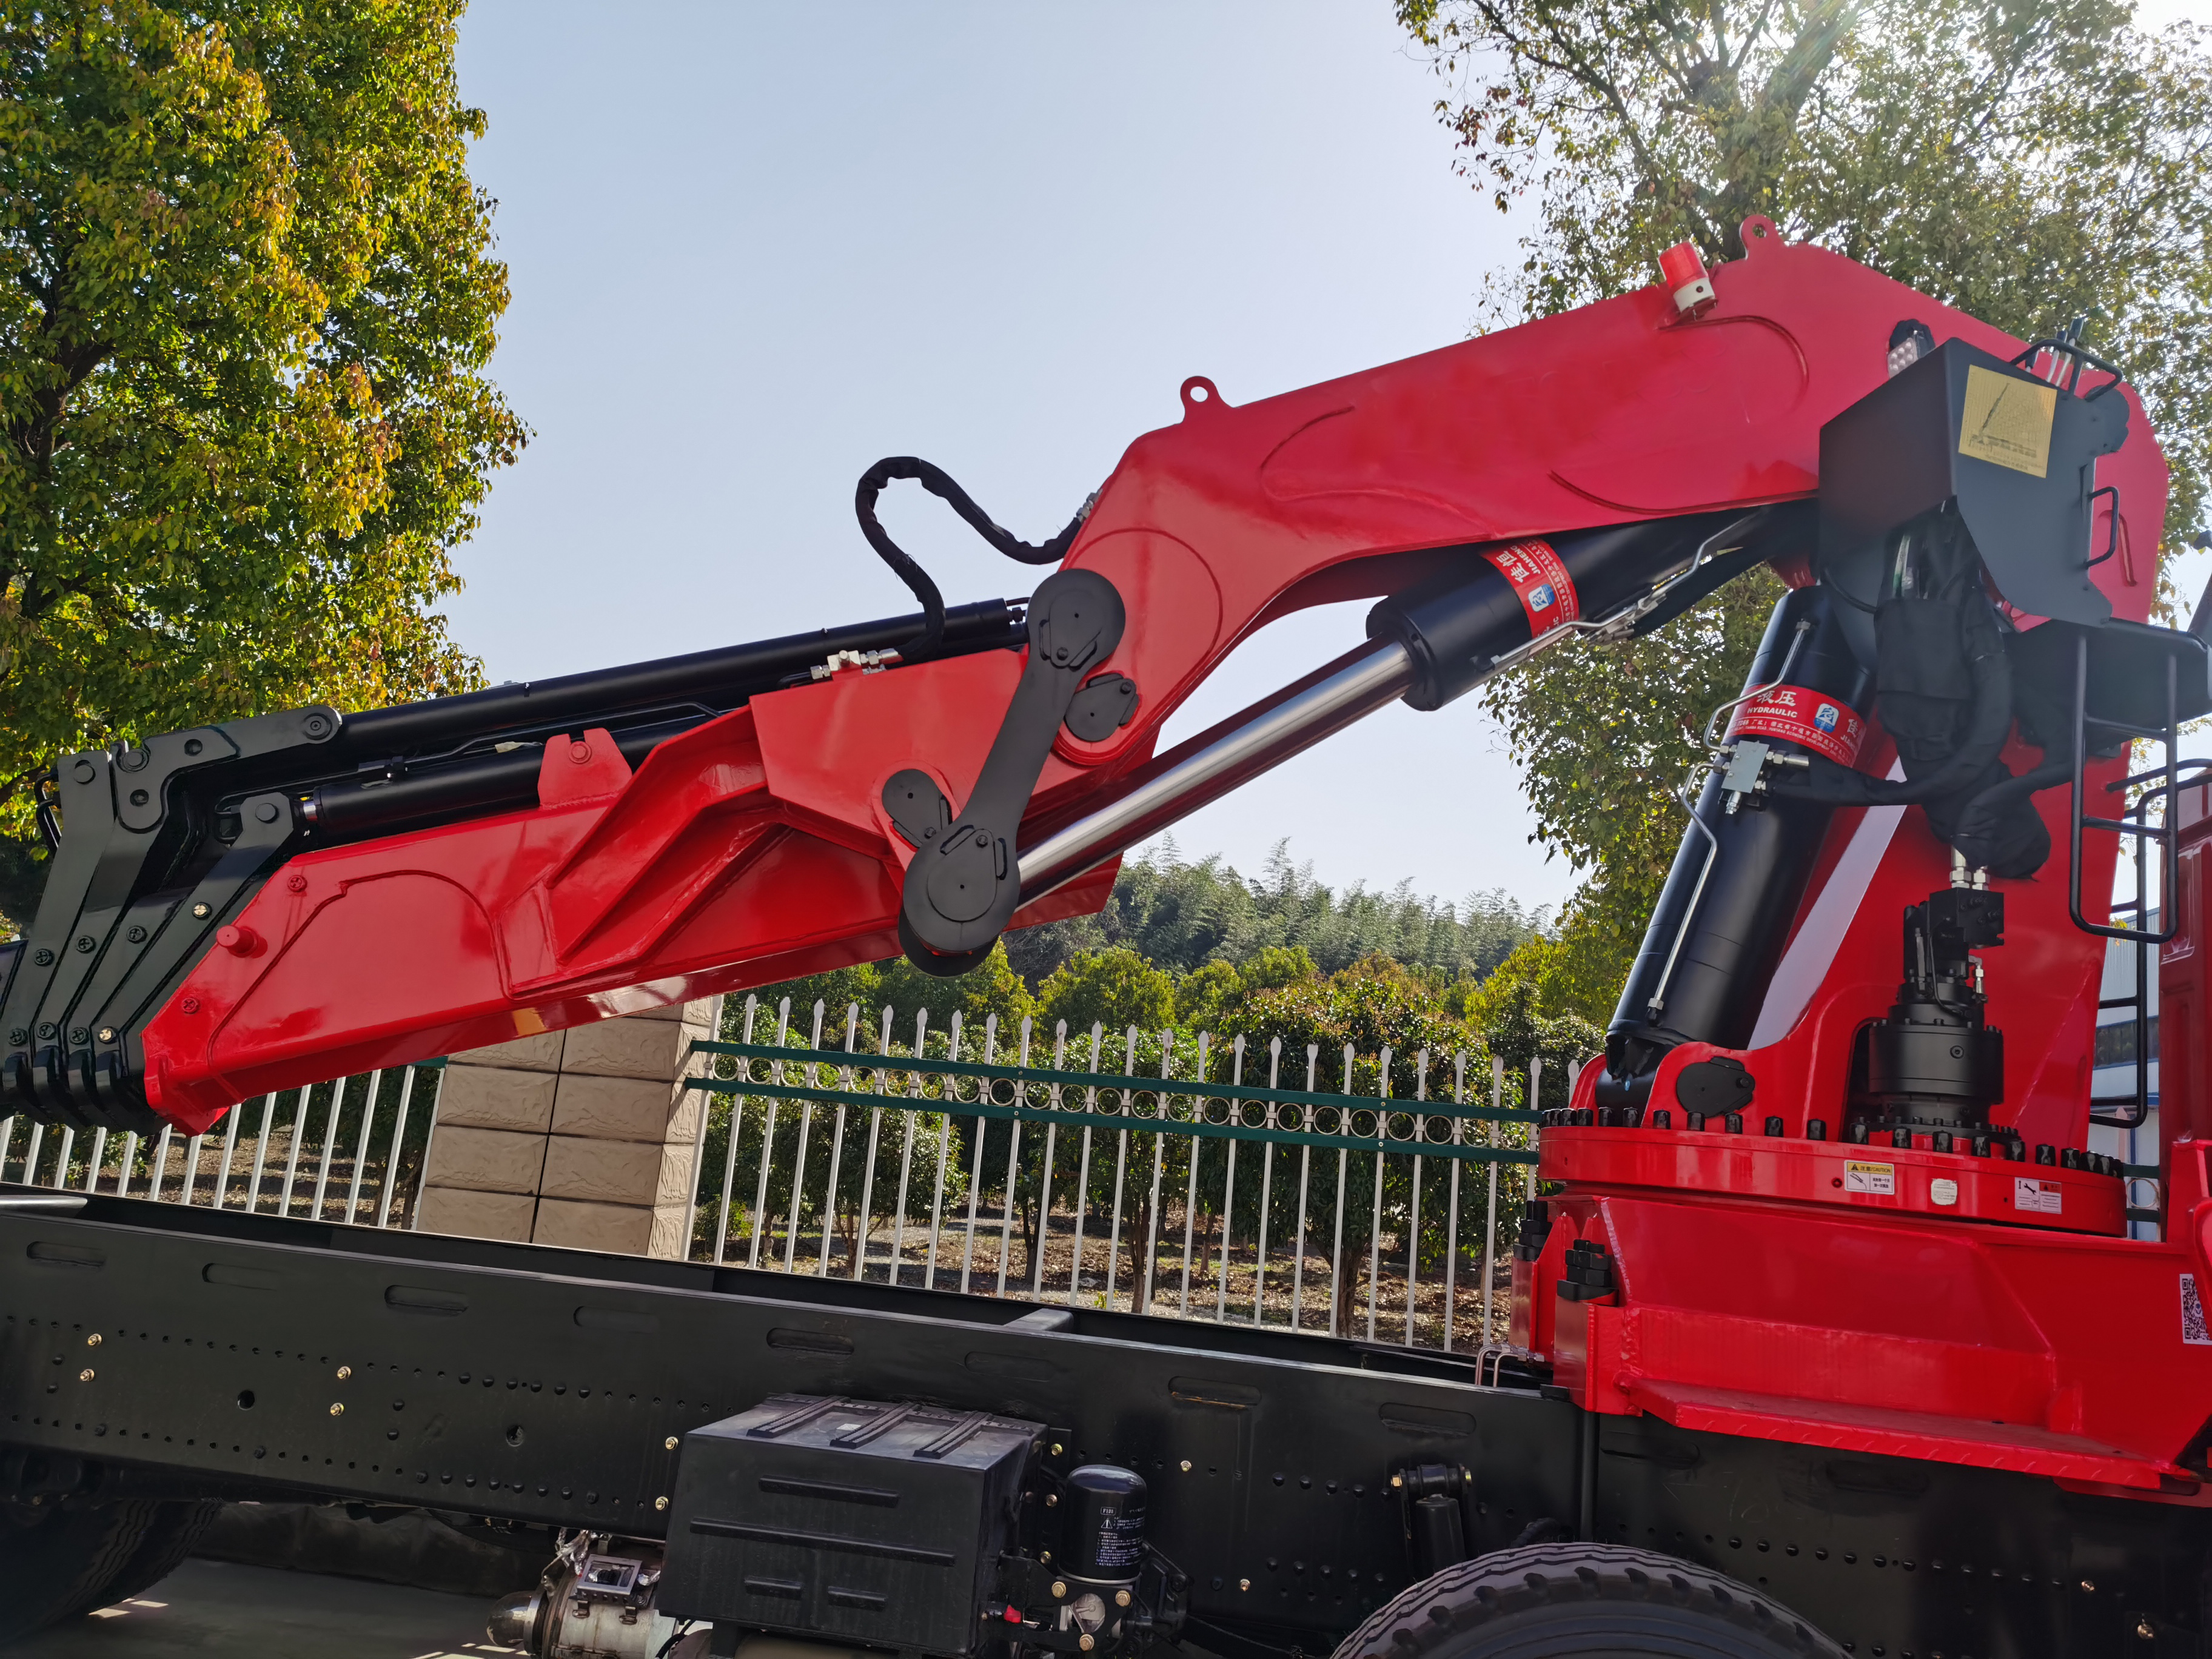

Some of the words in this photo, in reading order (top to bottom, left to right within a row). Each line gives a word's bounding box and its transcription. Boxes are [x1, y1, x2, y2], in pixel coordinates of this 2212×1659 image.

[1496, 551, 1530, 583] 佳恒
[1510, 545, 1541, 574] JIAHENG
[1757, 690, 1797, 706] 液压
[1747, 706, 1798, 718] HYDRAULIC
